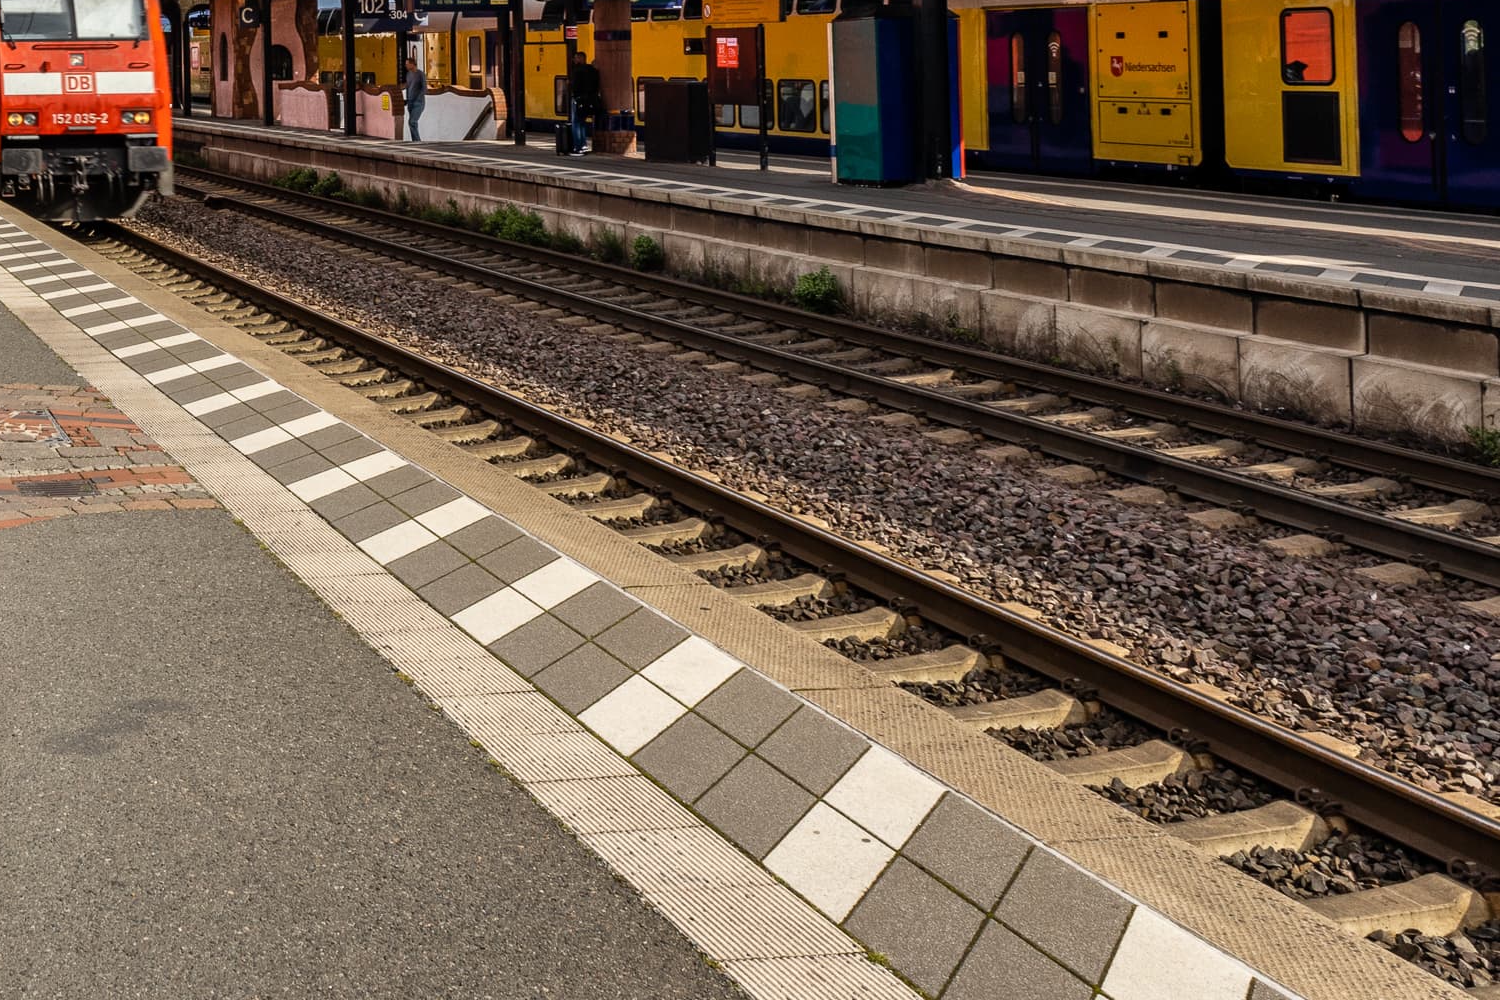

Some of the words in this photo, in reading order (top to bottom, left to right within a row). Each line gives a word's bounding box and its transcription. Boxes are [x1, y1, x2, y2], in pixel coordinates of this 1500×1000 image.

[241, 7, 254, 24] C
[1124, 62, 1177, 73] Niedersachsen
[67, 76, 91, 91] DB
[51, 113, 73, 125] 152
[74, 113, 109, 125] 035-2
